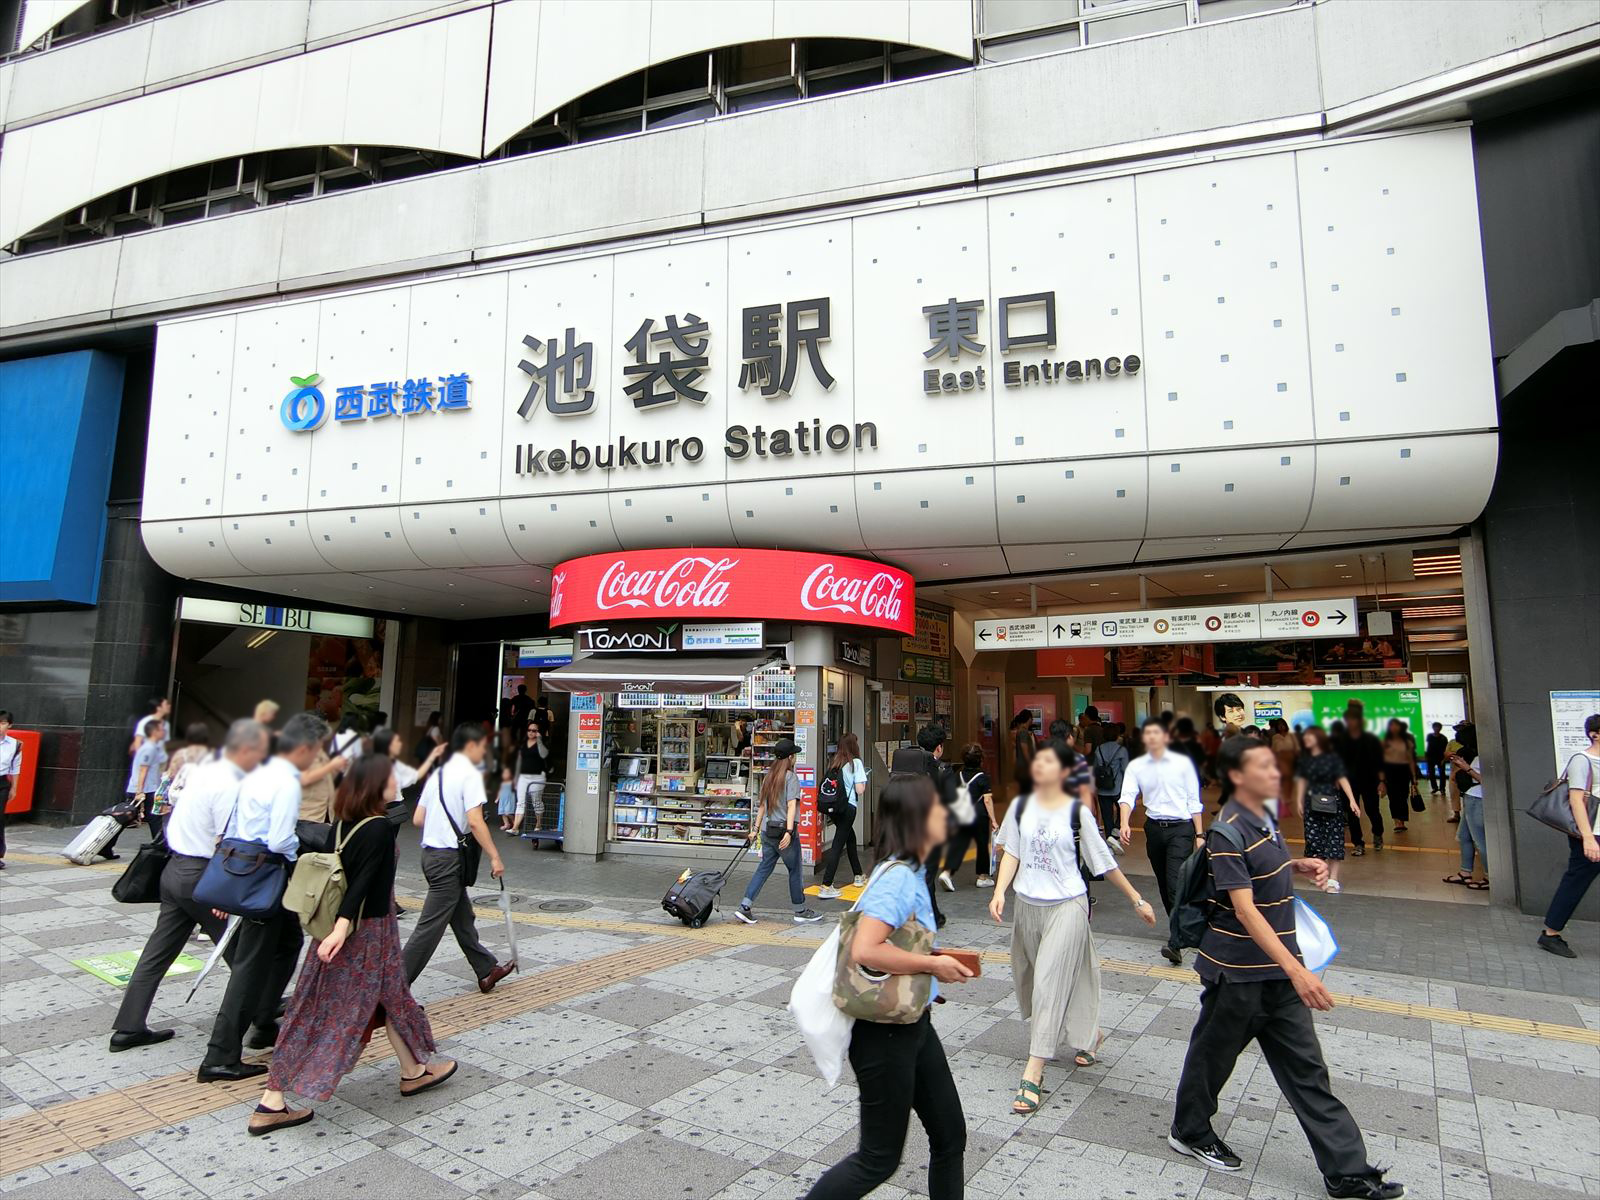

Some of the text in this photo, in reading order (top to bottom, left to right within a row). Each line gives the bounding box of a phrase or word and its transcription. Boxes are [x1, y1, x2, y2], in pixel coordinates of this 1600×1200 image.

[922, 290, 1057, 362] 東口
[516, 296, 838, 421] 池袋駅
[923, 354, 1141, 394] East Entrance
[334, 372, 473, 423] 西武鉄道
[515, 418, 878, 475] Ikebukuro Station
[596, 557, 740, 611] Coca-Cola
[800, 563, 904, 622] Coca-Cola
[240, 603, 312, 629] SEIBU
[621, 682, 655, 690] TOMONY
[580, 718, 600, 726] たばこ
